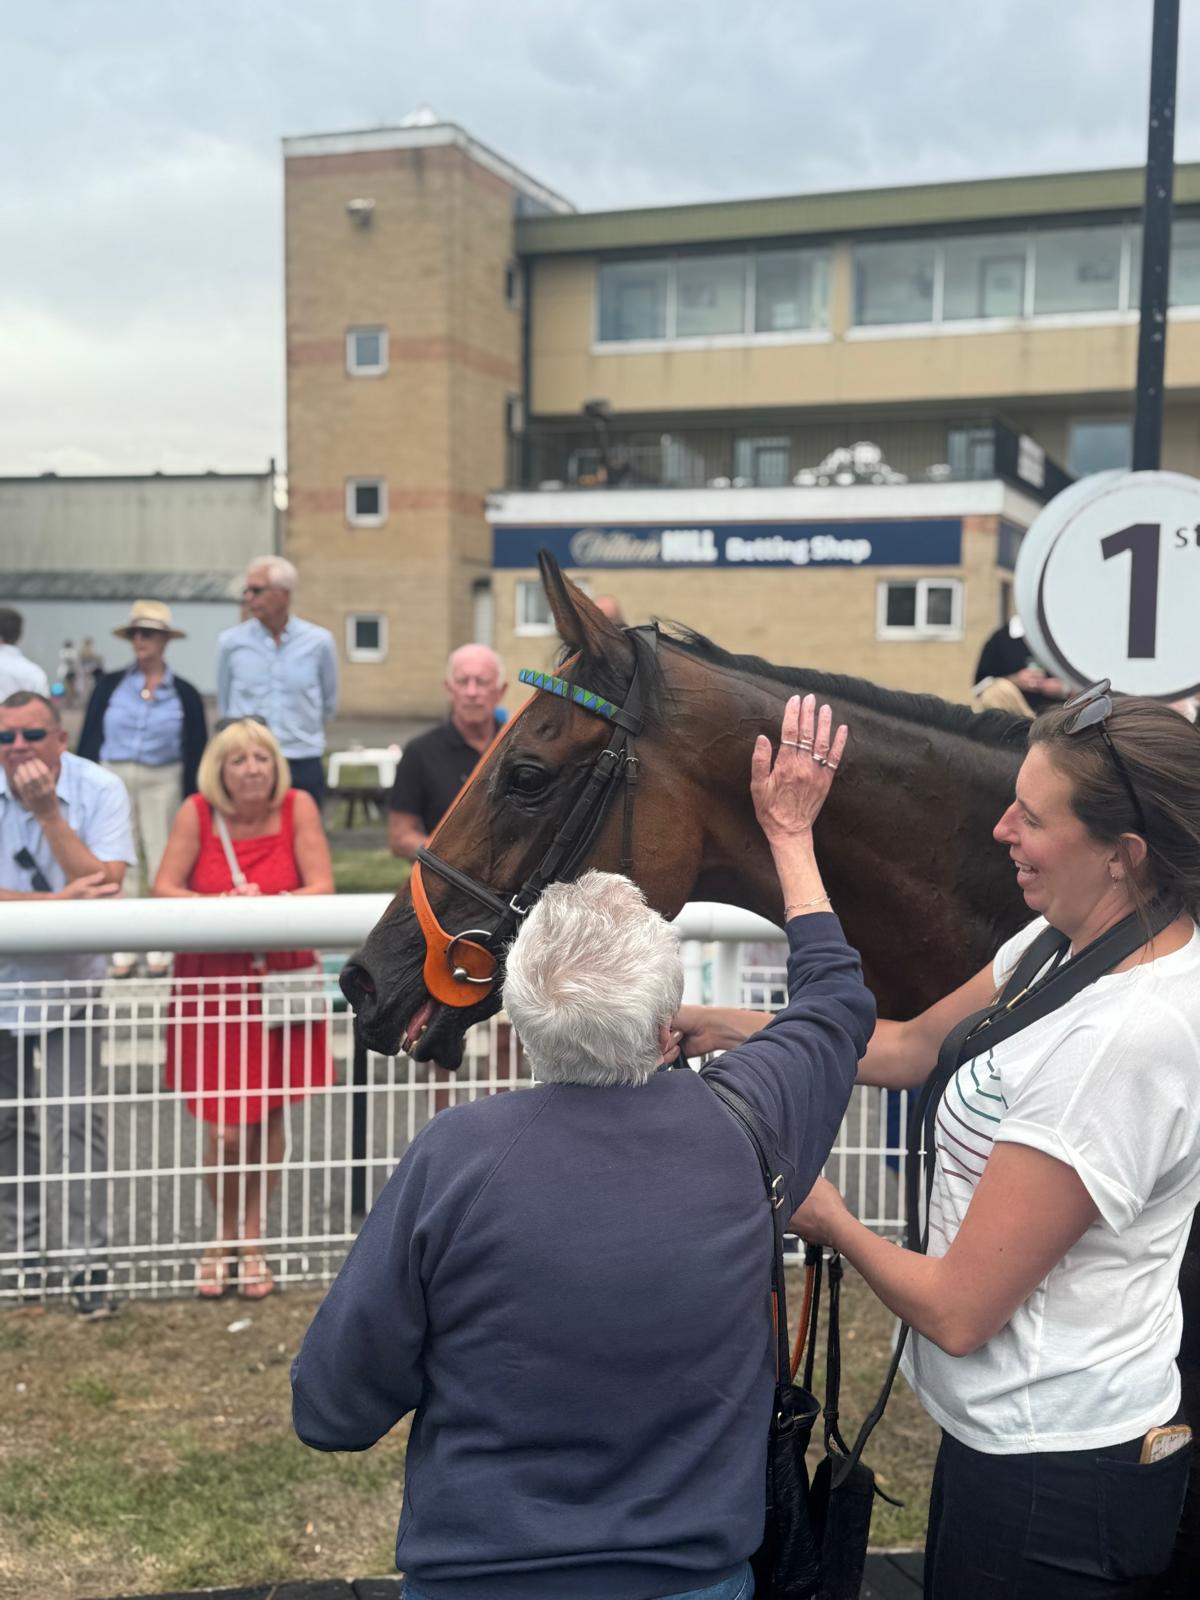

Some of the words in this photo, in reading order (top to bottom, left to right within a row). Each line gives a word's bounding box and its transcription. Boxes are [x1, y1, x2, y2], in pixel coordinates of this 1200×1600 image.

[661, 530, 718, 561] HILL
[725, 535, 810, 564] Betting
[810, 534, 871, 563] Shop
